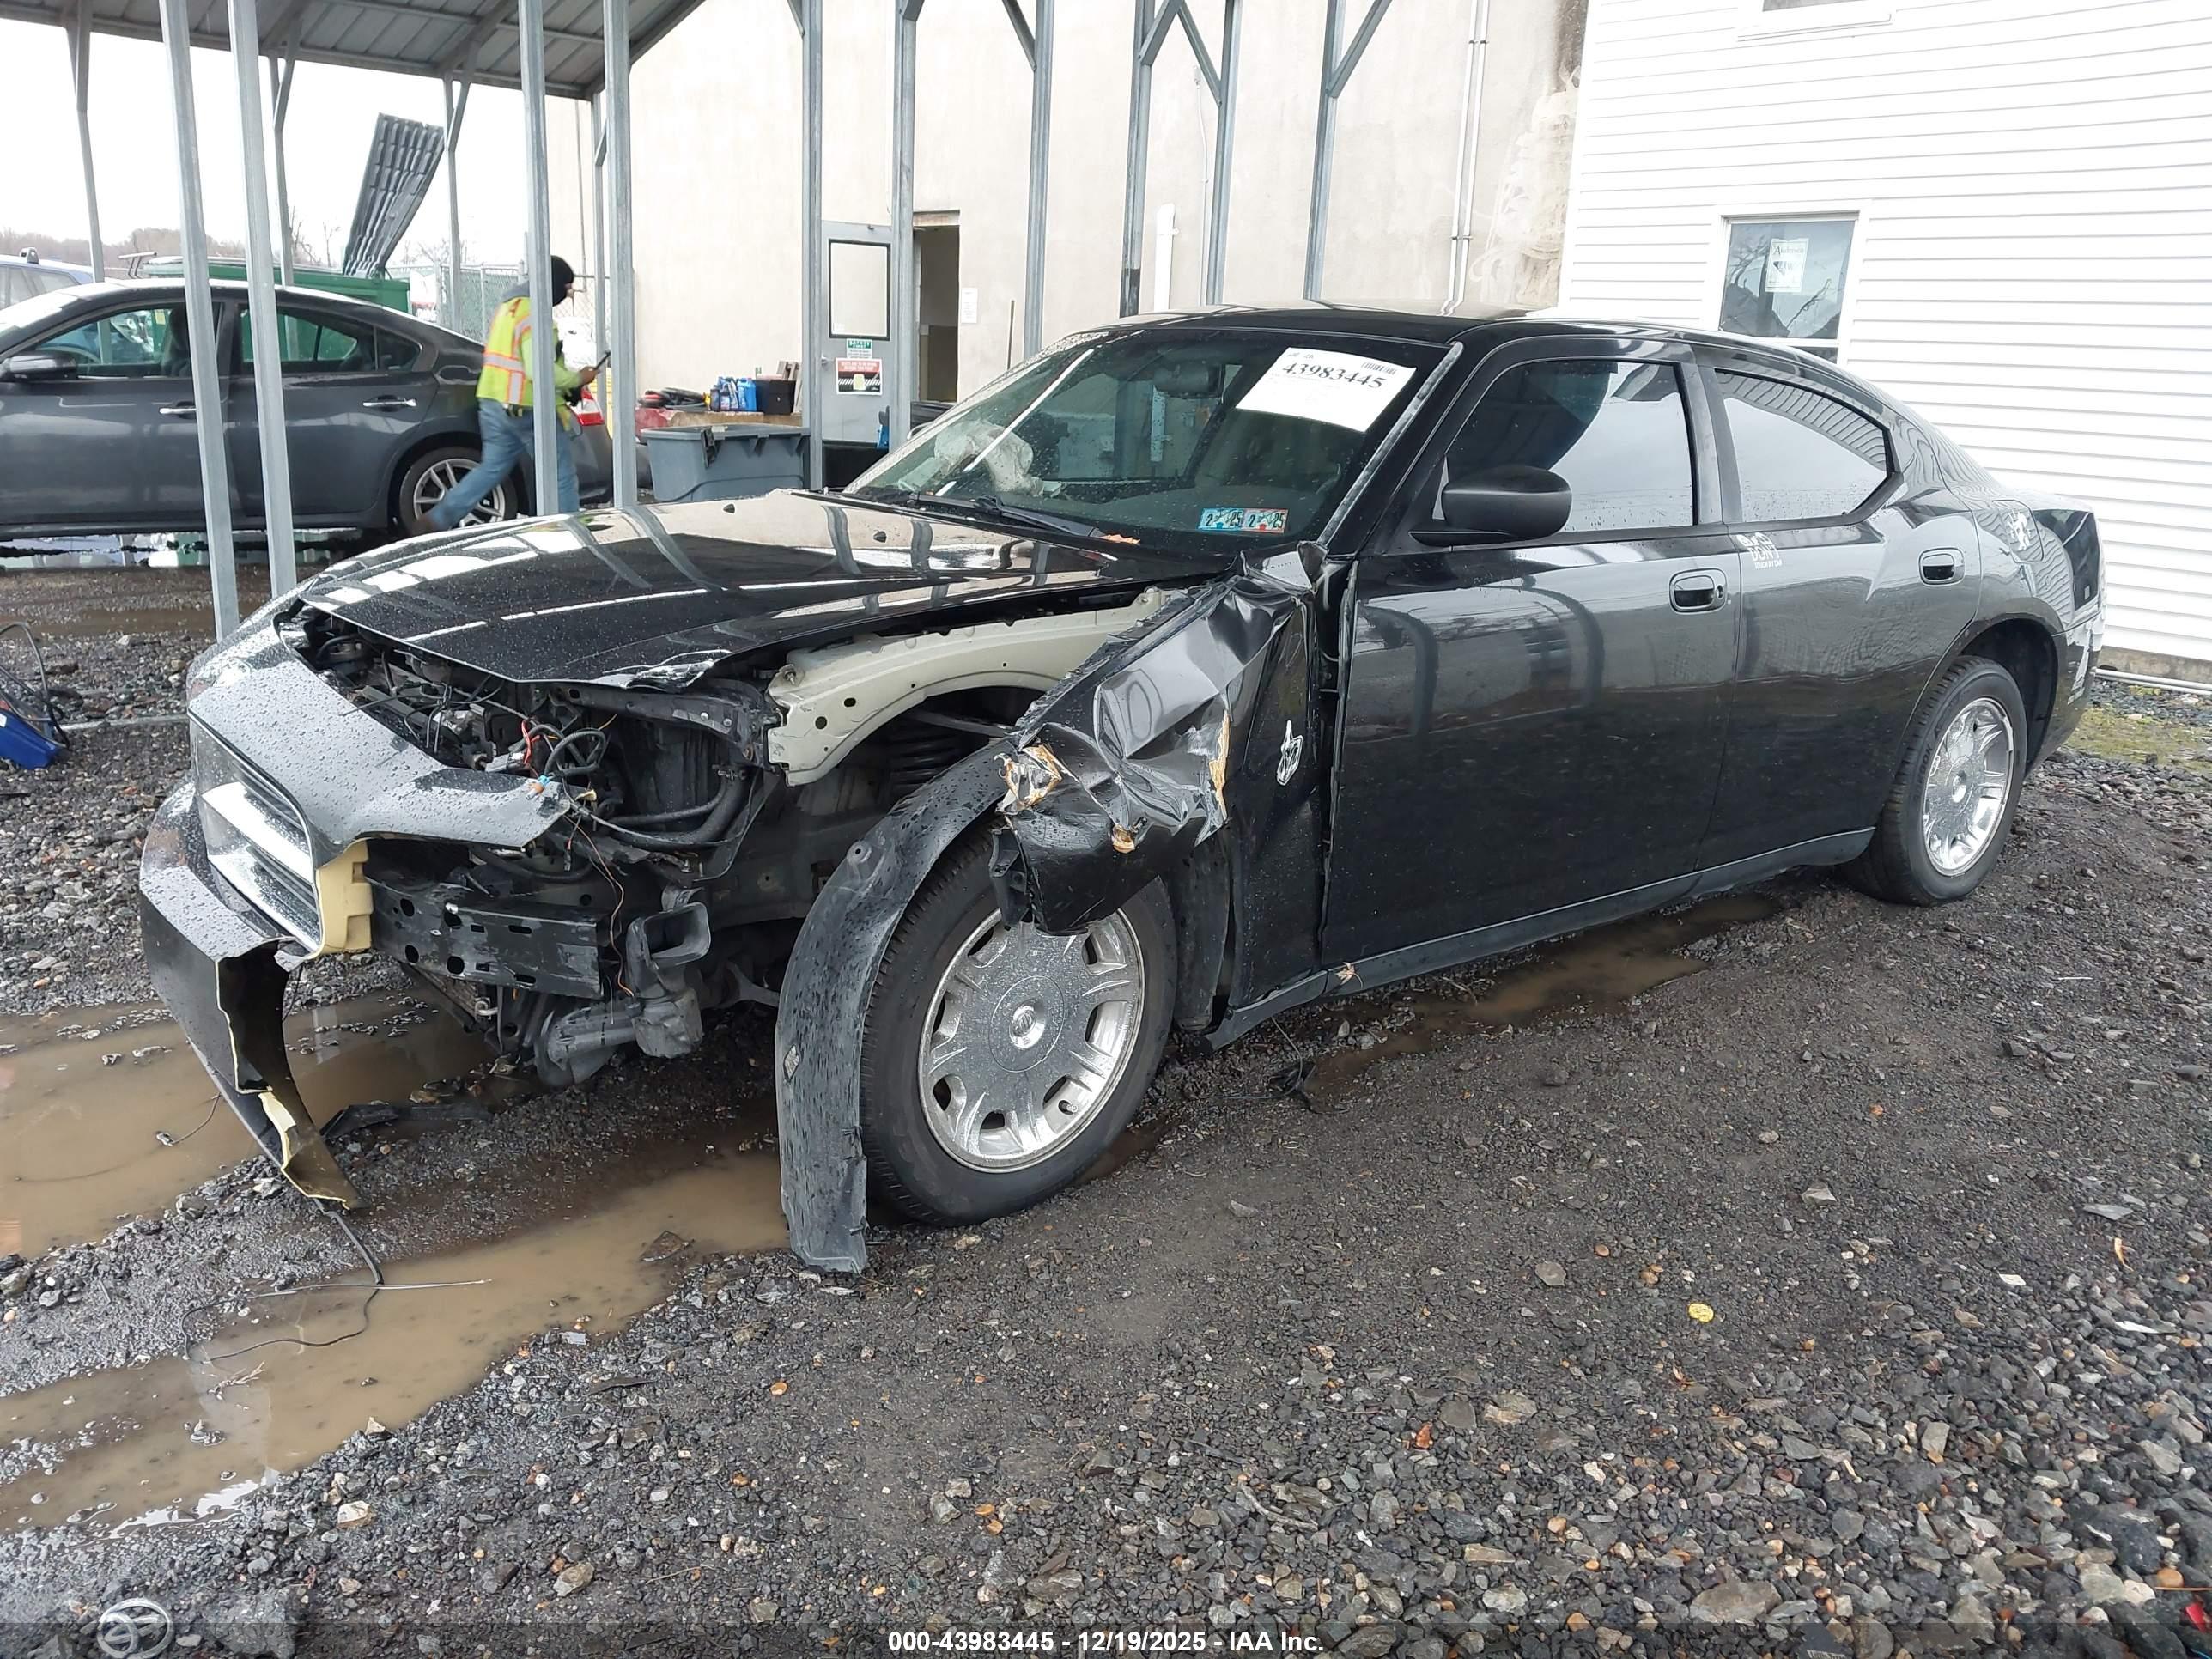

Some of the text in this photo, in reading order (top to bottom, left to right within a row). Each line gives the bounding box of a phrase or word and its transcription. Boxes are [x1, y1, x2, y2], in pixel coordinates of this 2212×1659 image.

[1282, 362, 1387, 389] 43983445
[1230, 512, 1243, 527] 25
[1273, 513, 1285, 528] 25
